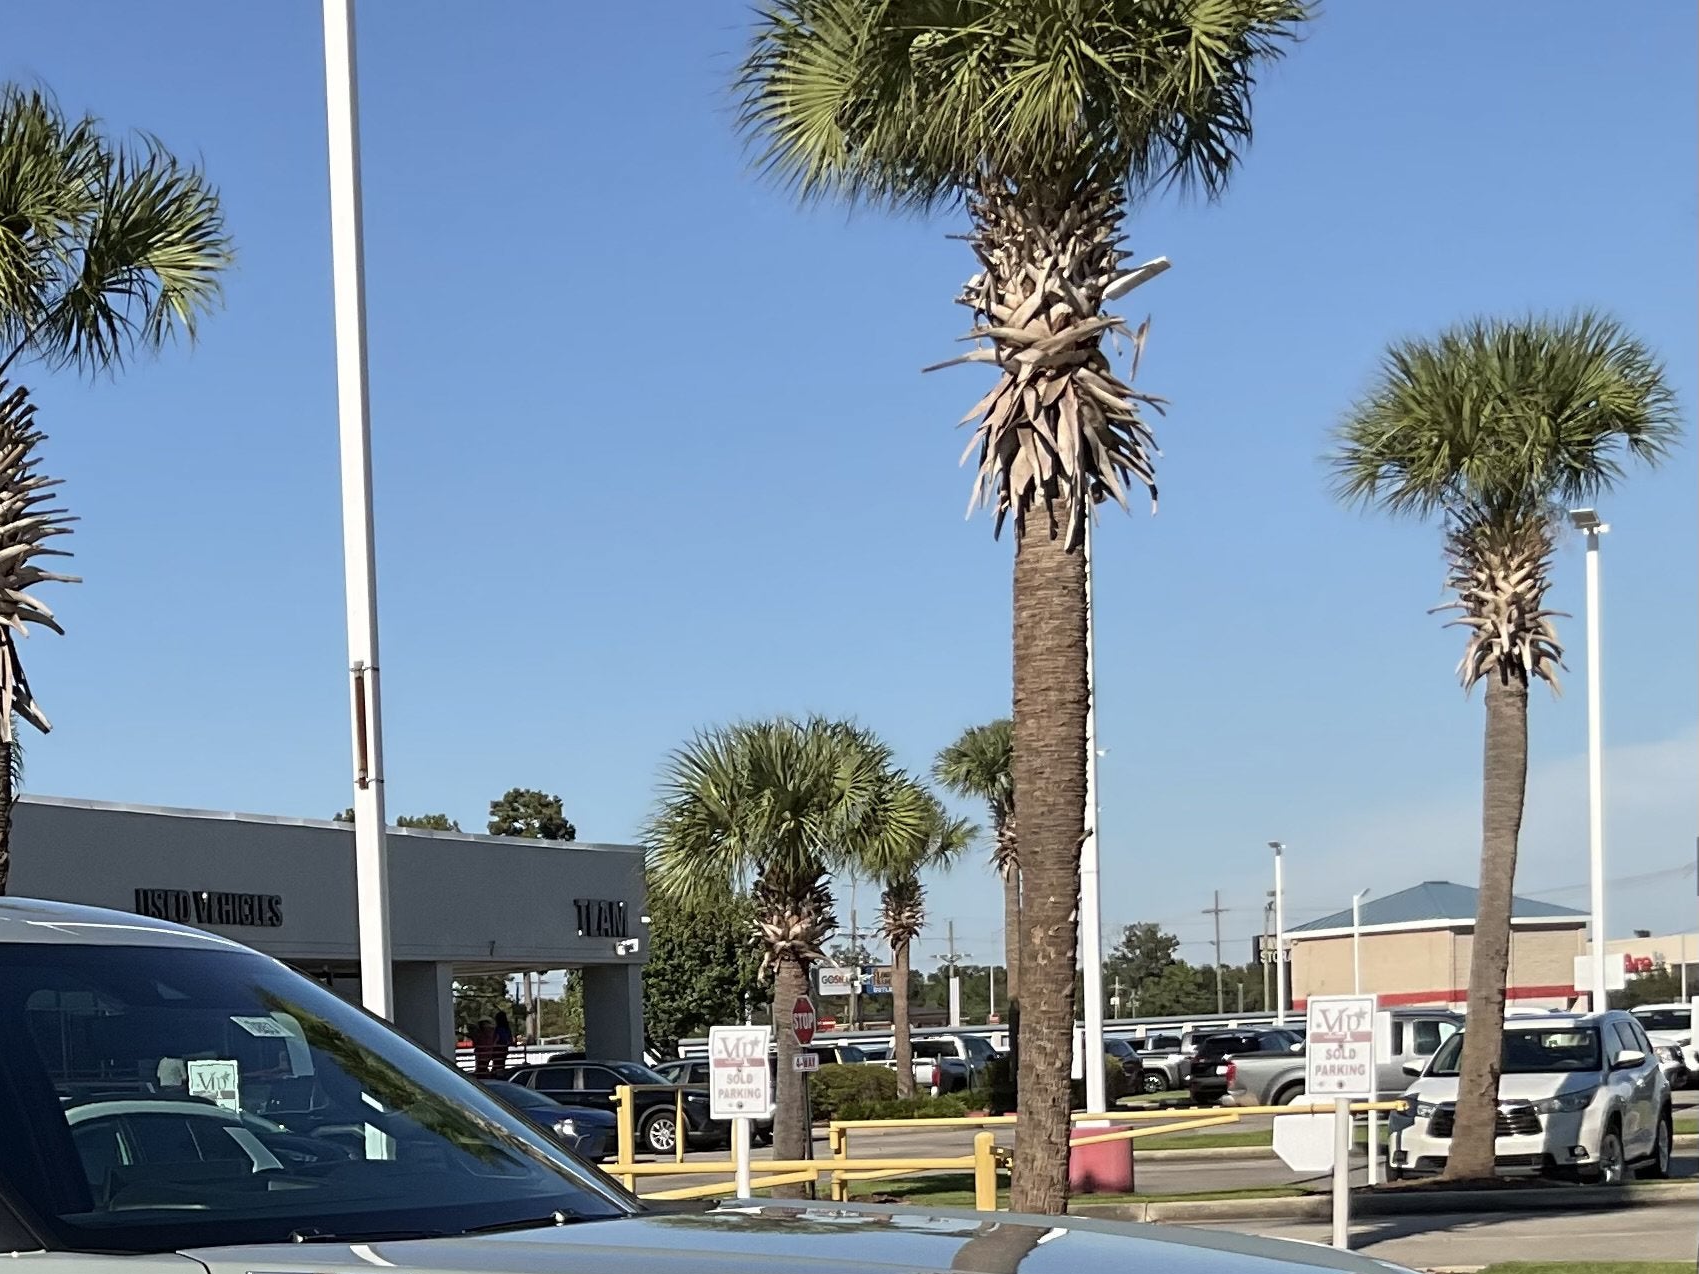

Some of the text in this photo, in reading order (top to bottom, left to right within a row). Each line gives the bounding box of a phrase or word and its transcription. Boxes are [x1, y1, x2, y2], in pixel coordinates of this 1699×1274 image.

[192, 890, 283, 928] VEHICLES
[794, 1012, 814, 1030] STOP
[1325, 1048, 1356, 1060] SOLD
[795, 1055, 816, 1068] 4-WAY
[1315, 1064, 1366, 1076] PARKING
[726, 1073, 753, 1085] SOLD
[718, 1087, 761, 1100] PARKING
